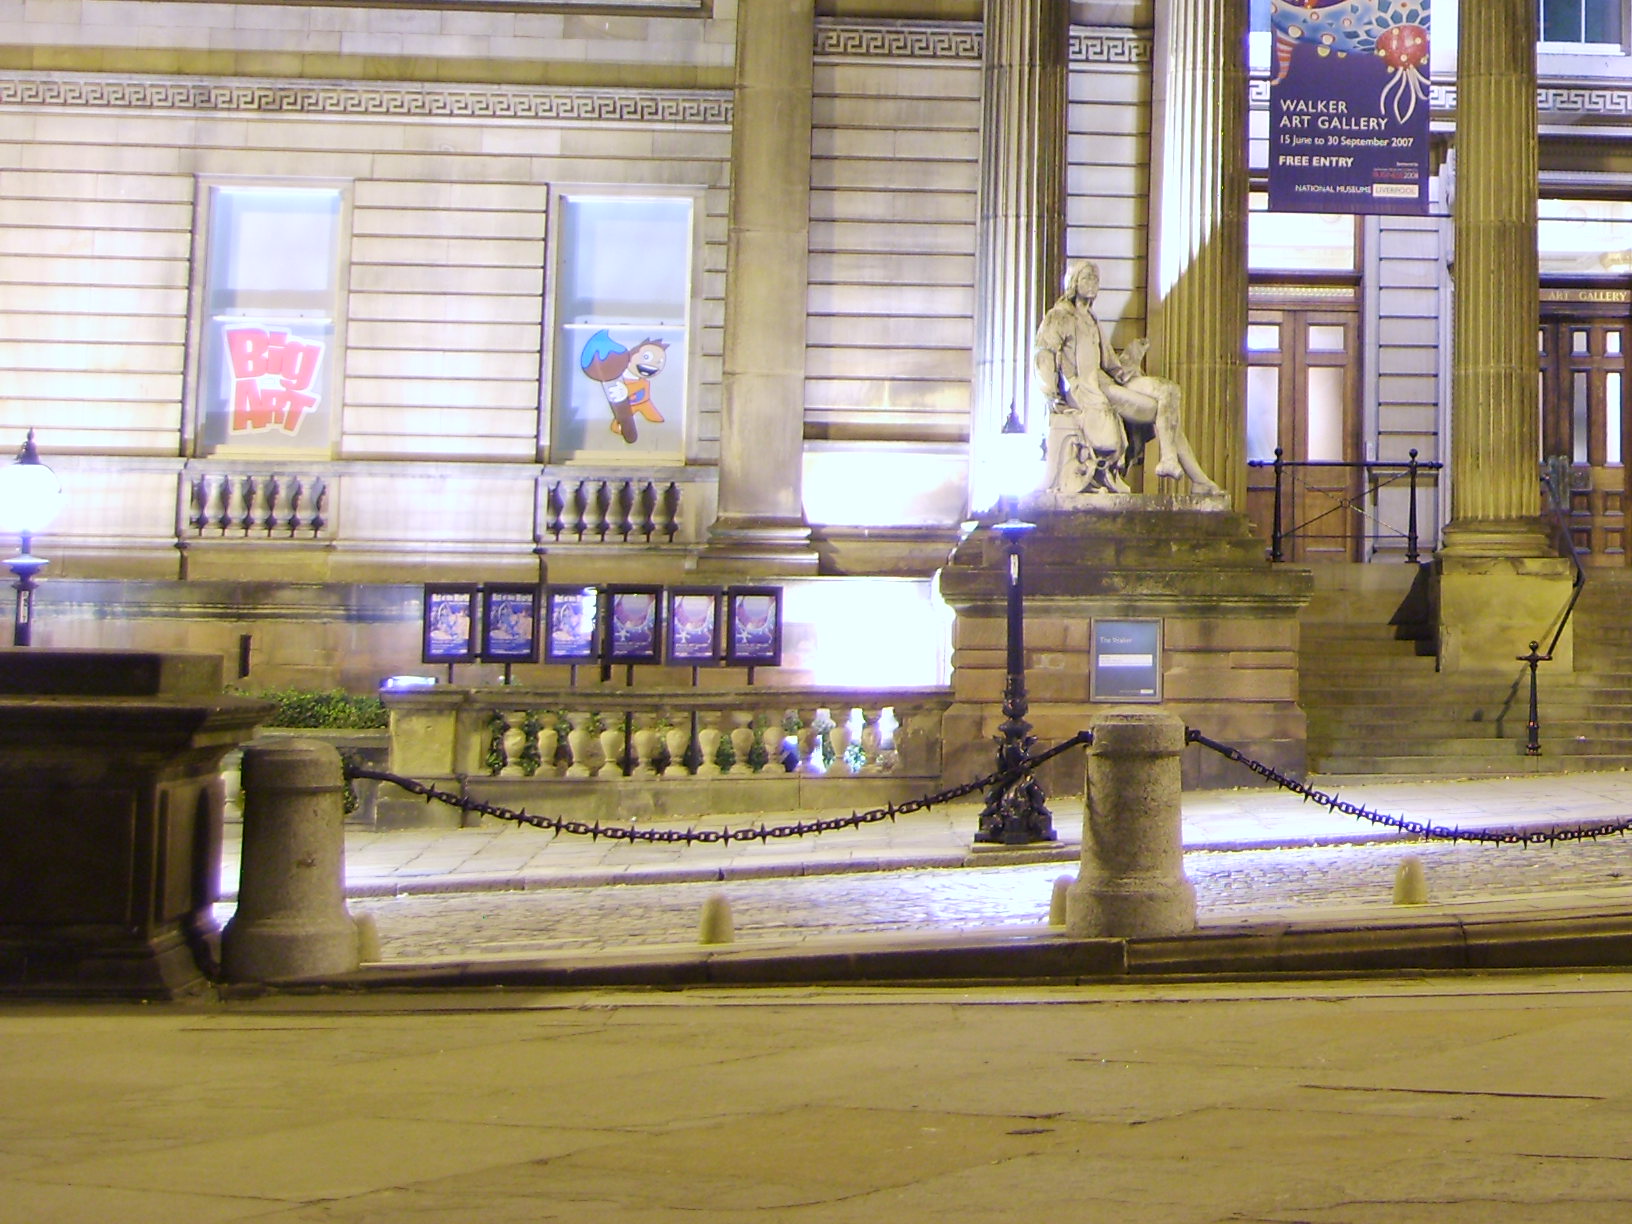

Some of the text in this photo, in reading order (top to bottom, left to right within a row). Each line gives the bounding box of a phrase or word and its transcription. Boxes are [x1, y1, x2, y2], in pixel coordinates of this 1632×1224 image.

[1280, 99, 1348, 113] WALKER
[1280, 115, 1388, 131] ART GALLERY
[1280, 134, 1414, 148] 15 June to 30 September 2007
[1279, 156, 1354, 167] FREE ENTRY
[1548, 291, 1628, 302] ART GALLERY
[226, 327, 322, 391] Big
[232, 378, 318, 432] ART
